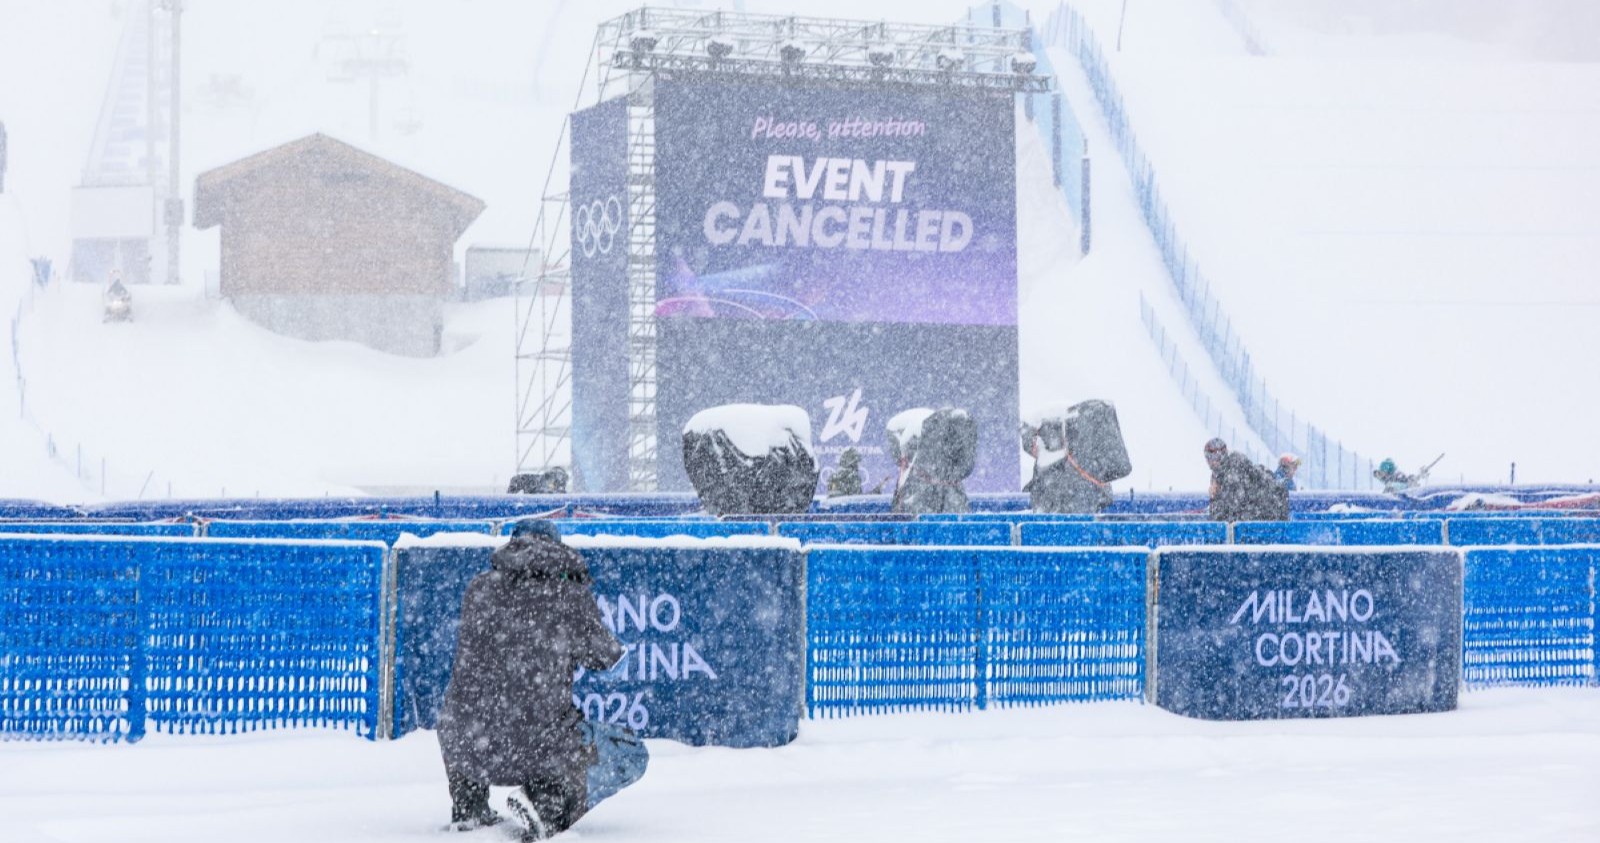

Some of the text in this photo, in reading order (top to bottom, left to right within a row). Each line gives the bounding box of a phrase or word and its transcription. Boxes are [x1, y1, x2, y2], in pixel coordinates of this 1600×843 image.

[751, 116, 926, 140] Please, attention
[763, 155, 915, 203] EVENT
[703, 201, 974, 252] CANCELLED
[596, 593, 681, 633] ANO
[1230, 589, 1374, 624] MILANO
[573, 640, 718, 682] TINA
[1255, 630, 1401, 667] CORTINA
[1281, 673, 1350, 708] 2026
[573, 692, 649, 731] 026
